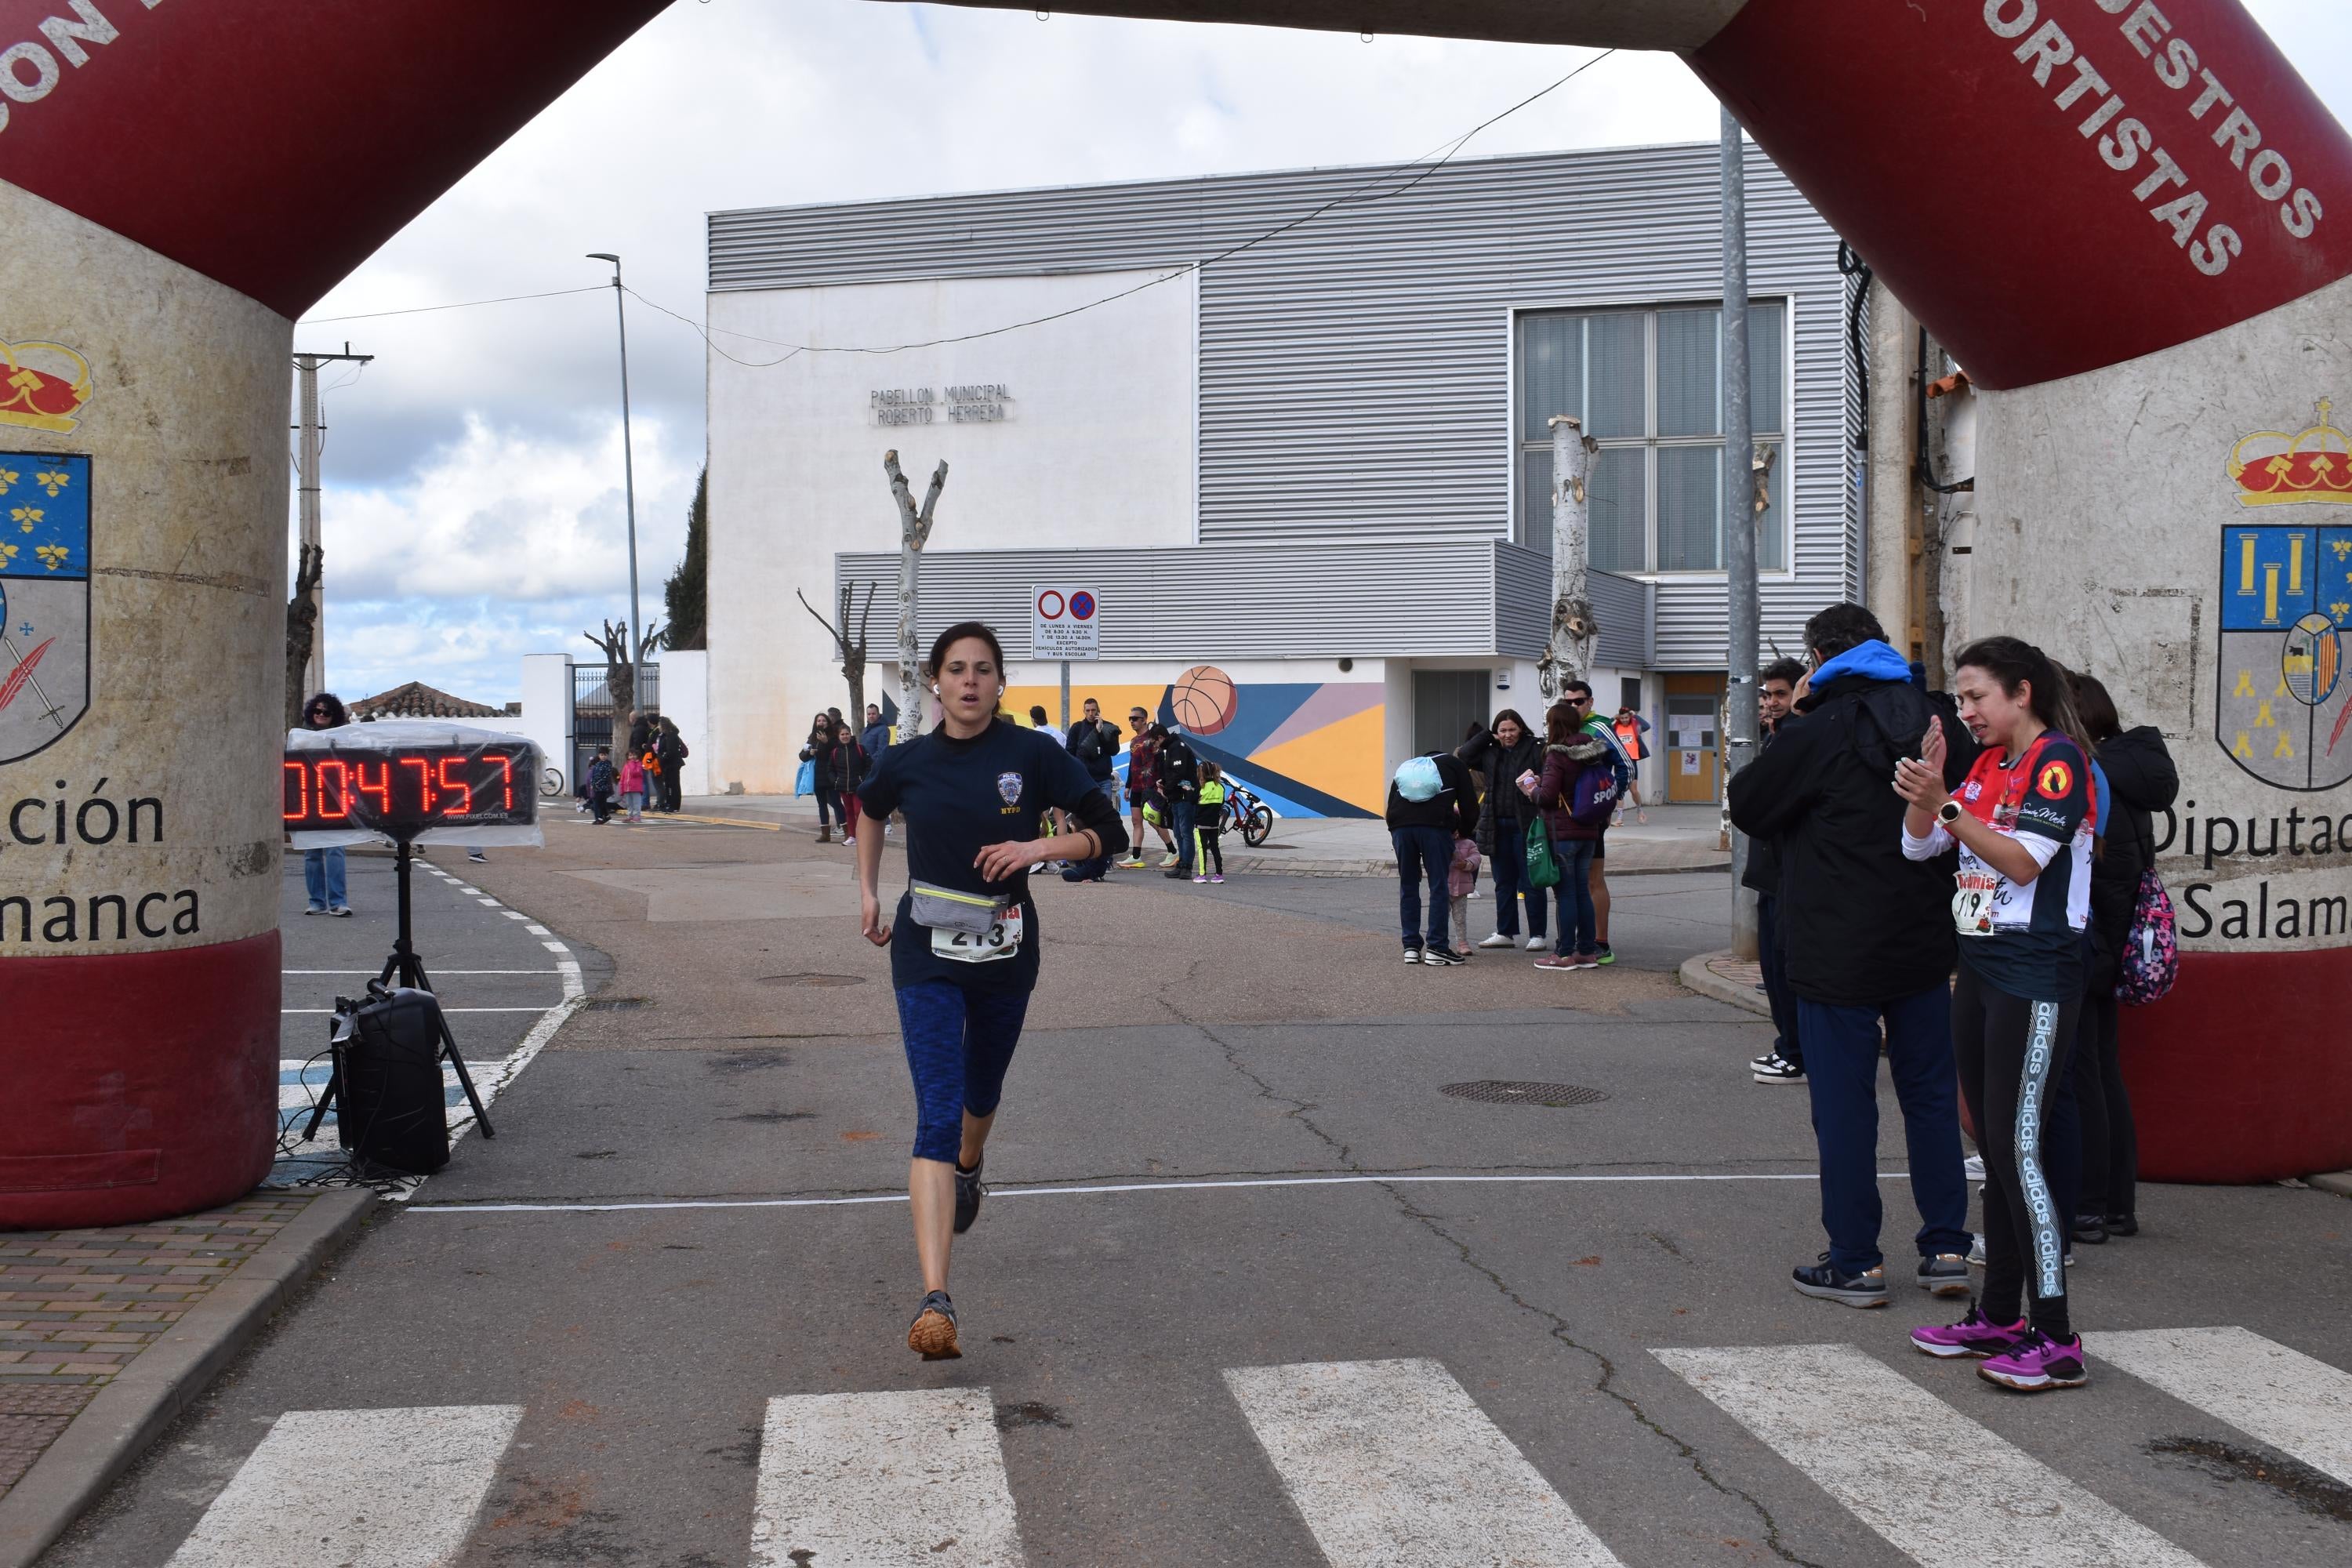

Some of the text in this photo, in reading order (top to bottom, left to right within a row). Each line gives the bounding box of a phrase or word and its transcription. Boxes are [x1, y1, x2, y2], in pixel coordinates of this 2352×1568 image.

[2094, 0, 2323, 238] ESTROS
[877, 404, 1004, 426] ROBERTO HERRERA
[945, 383, 1011, 403] MUNICIPAL
[2180, 881, 2352, 939] Salam
[2020, 1002, 2059, 1296] adidas adidas adidas adidas
